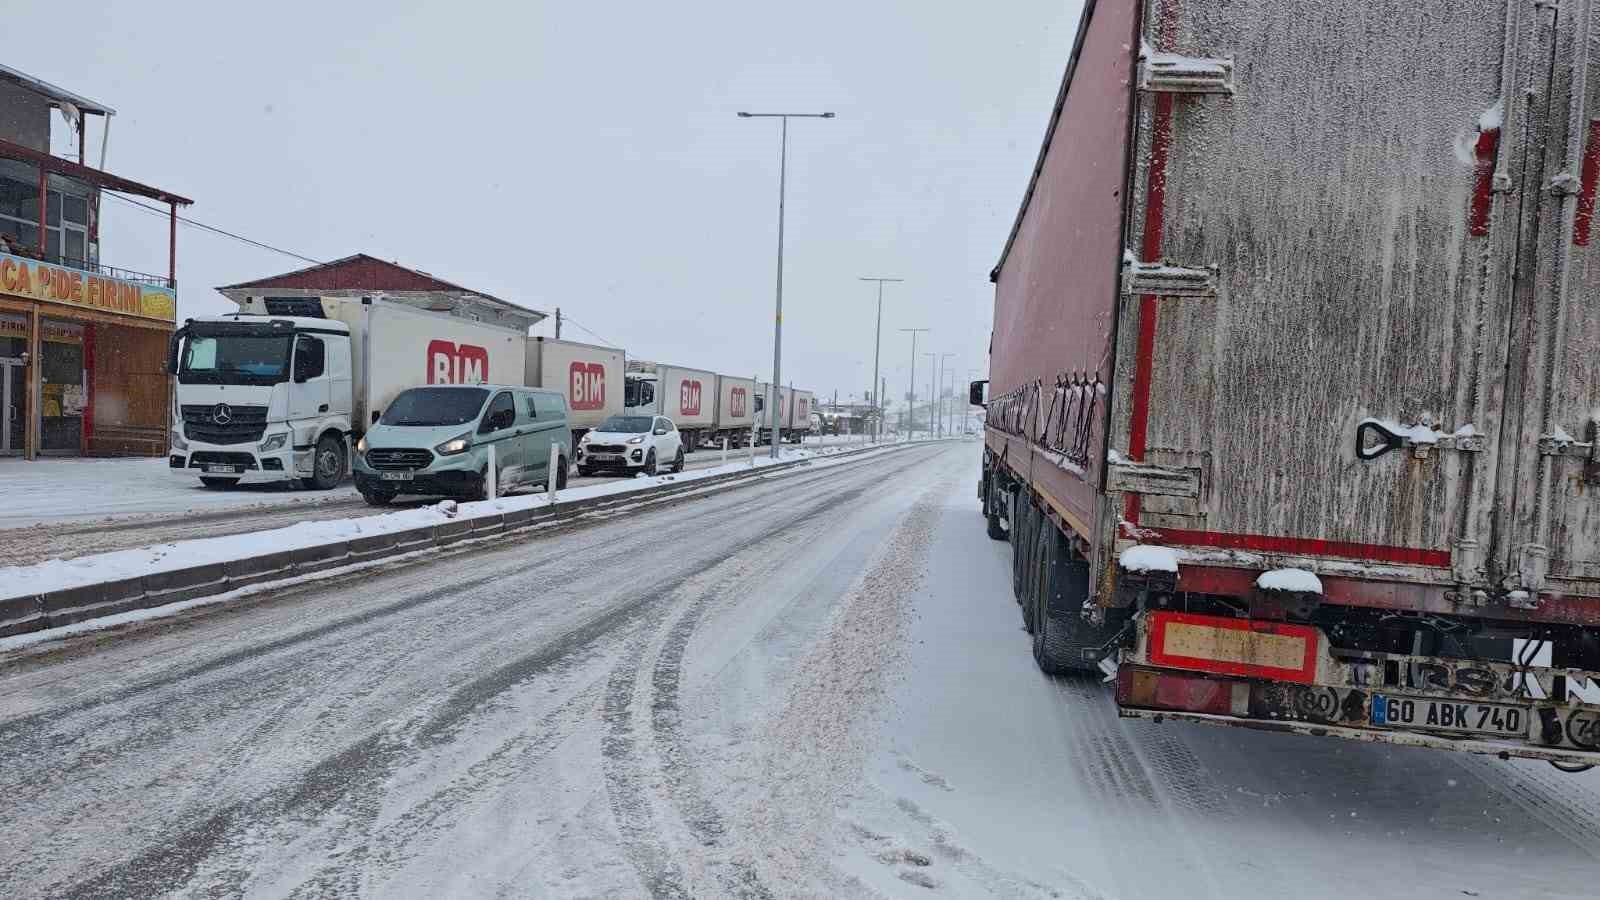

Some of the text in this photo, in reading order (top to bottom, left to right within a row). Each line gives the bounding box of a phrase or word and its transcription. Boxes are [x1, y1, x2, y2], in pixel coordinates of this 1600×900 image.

[87, 274, 142, 313] FIRINI
[432, 351, 484, 386] BIM
[573, 371, 603, 403] BIM
[682, 388, 700, 410] BIM
[1387, 699, 1520, 732] 60 ABK 740
